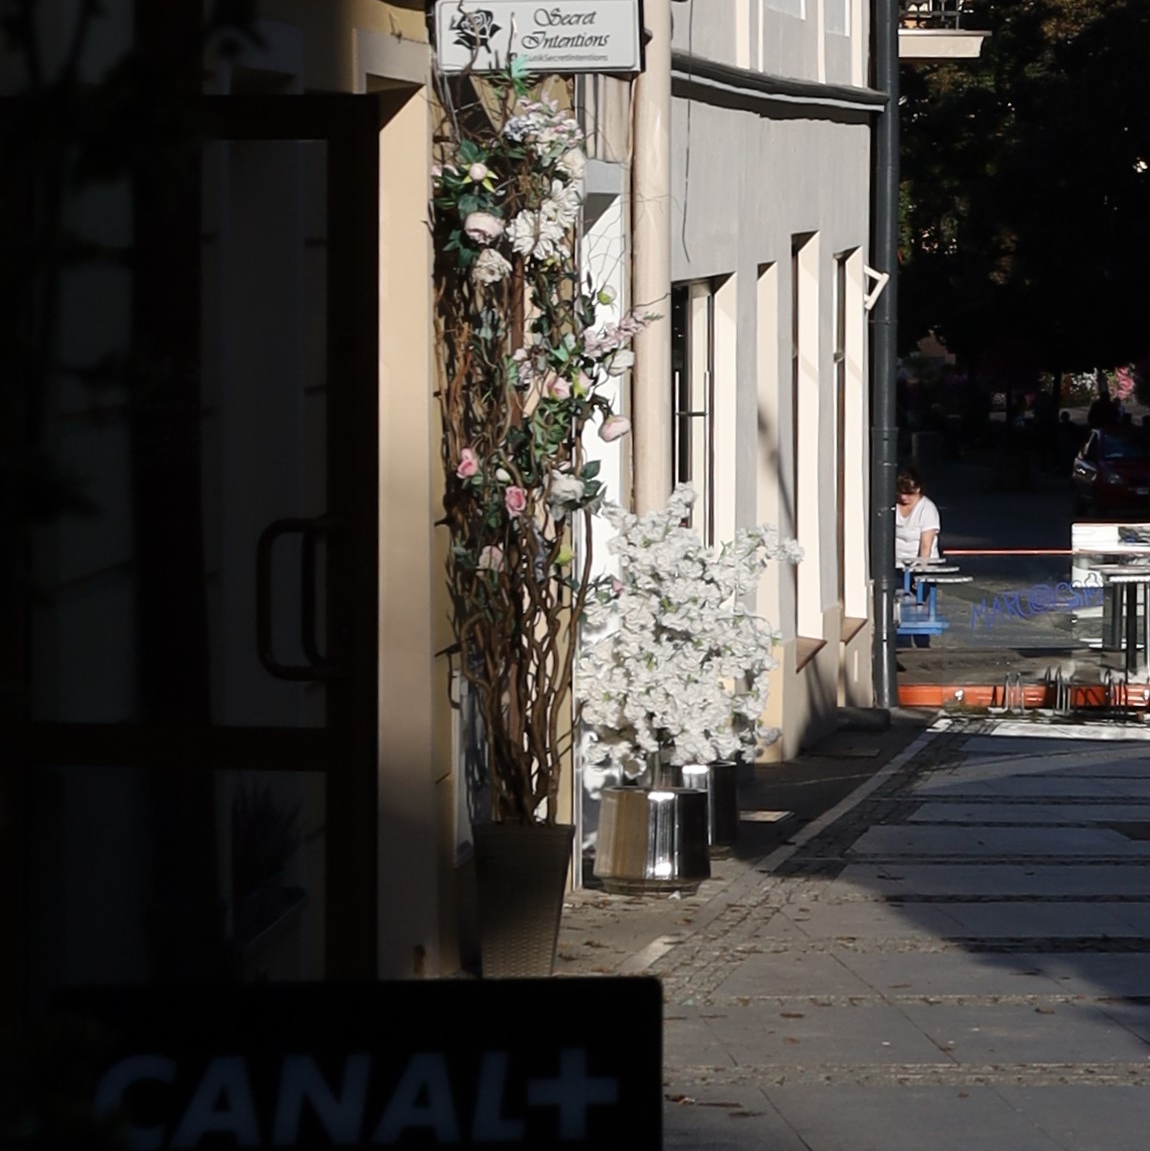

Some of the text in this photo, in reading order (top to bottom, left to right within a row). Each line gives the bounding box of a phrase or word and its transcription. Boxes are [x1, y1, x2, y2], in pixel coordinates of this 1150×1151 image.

[533, 7, 597, 27] Secret
[521, 31, 610, 50] Intentions
[94, 1045, 620, 1151] CANAL+
